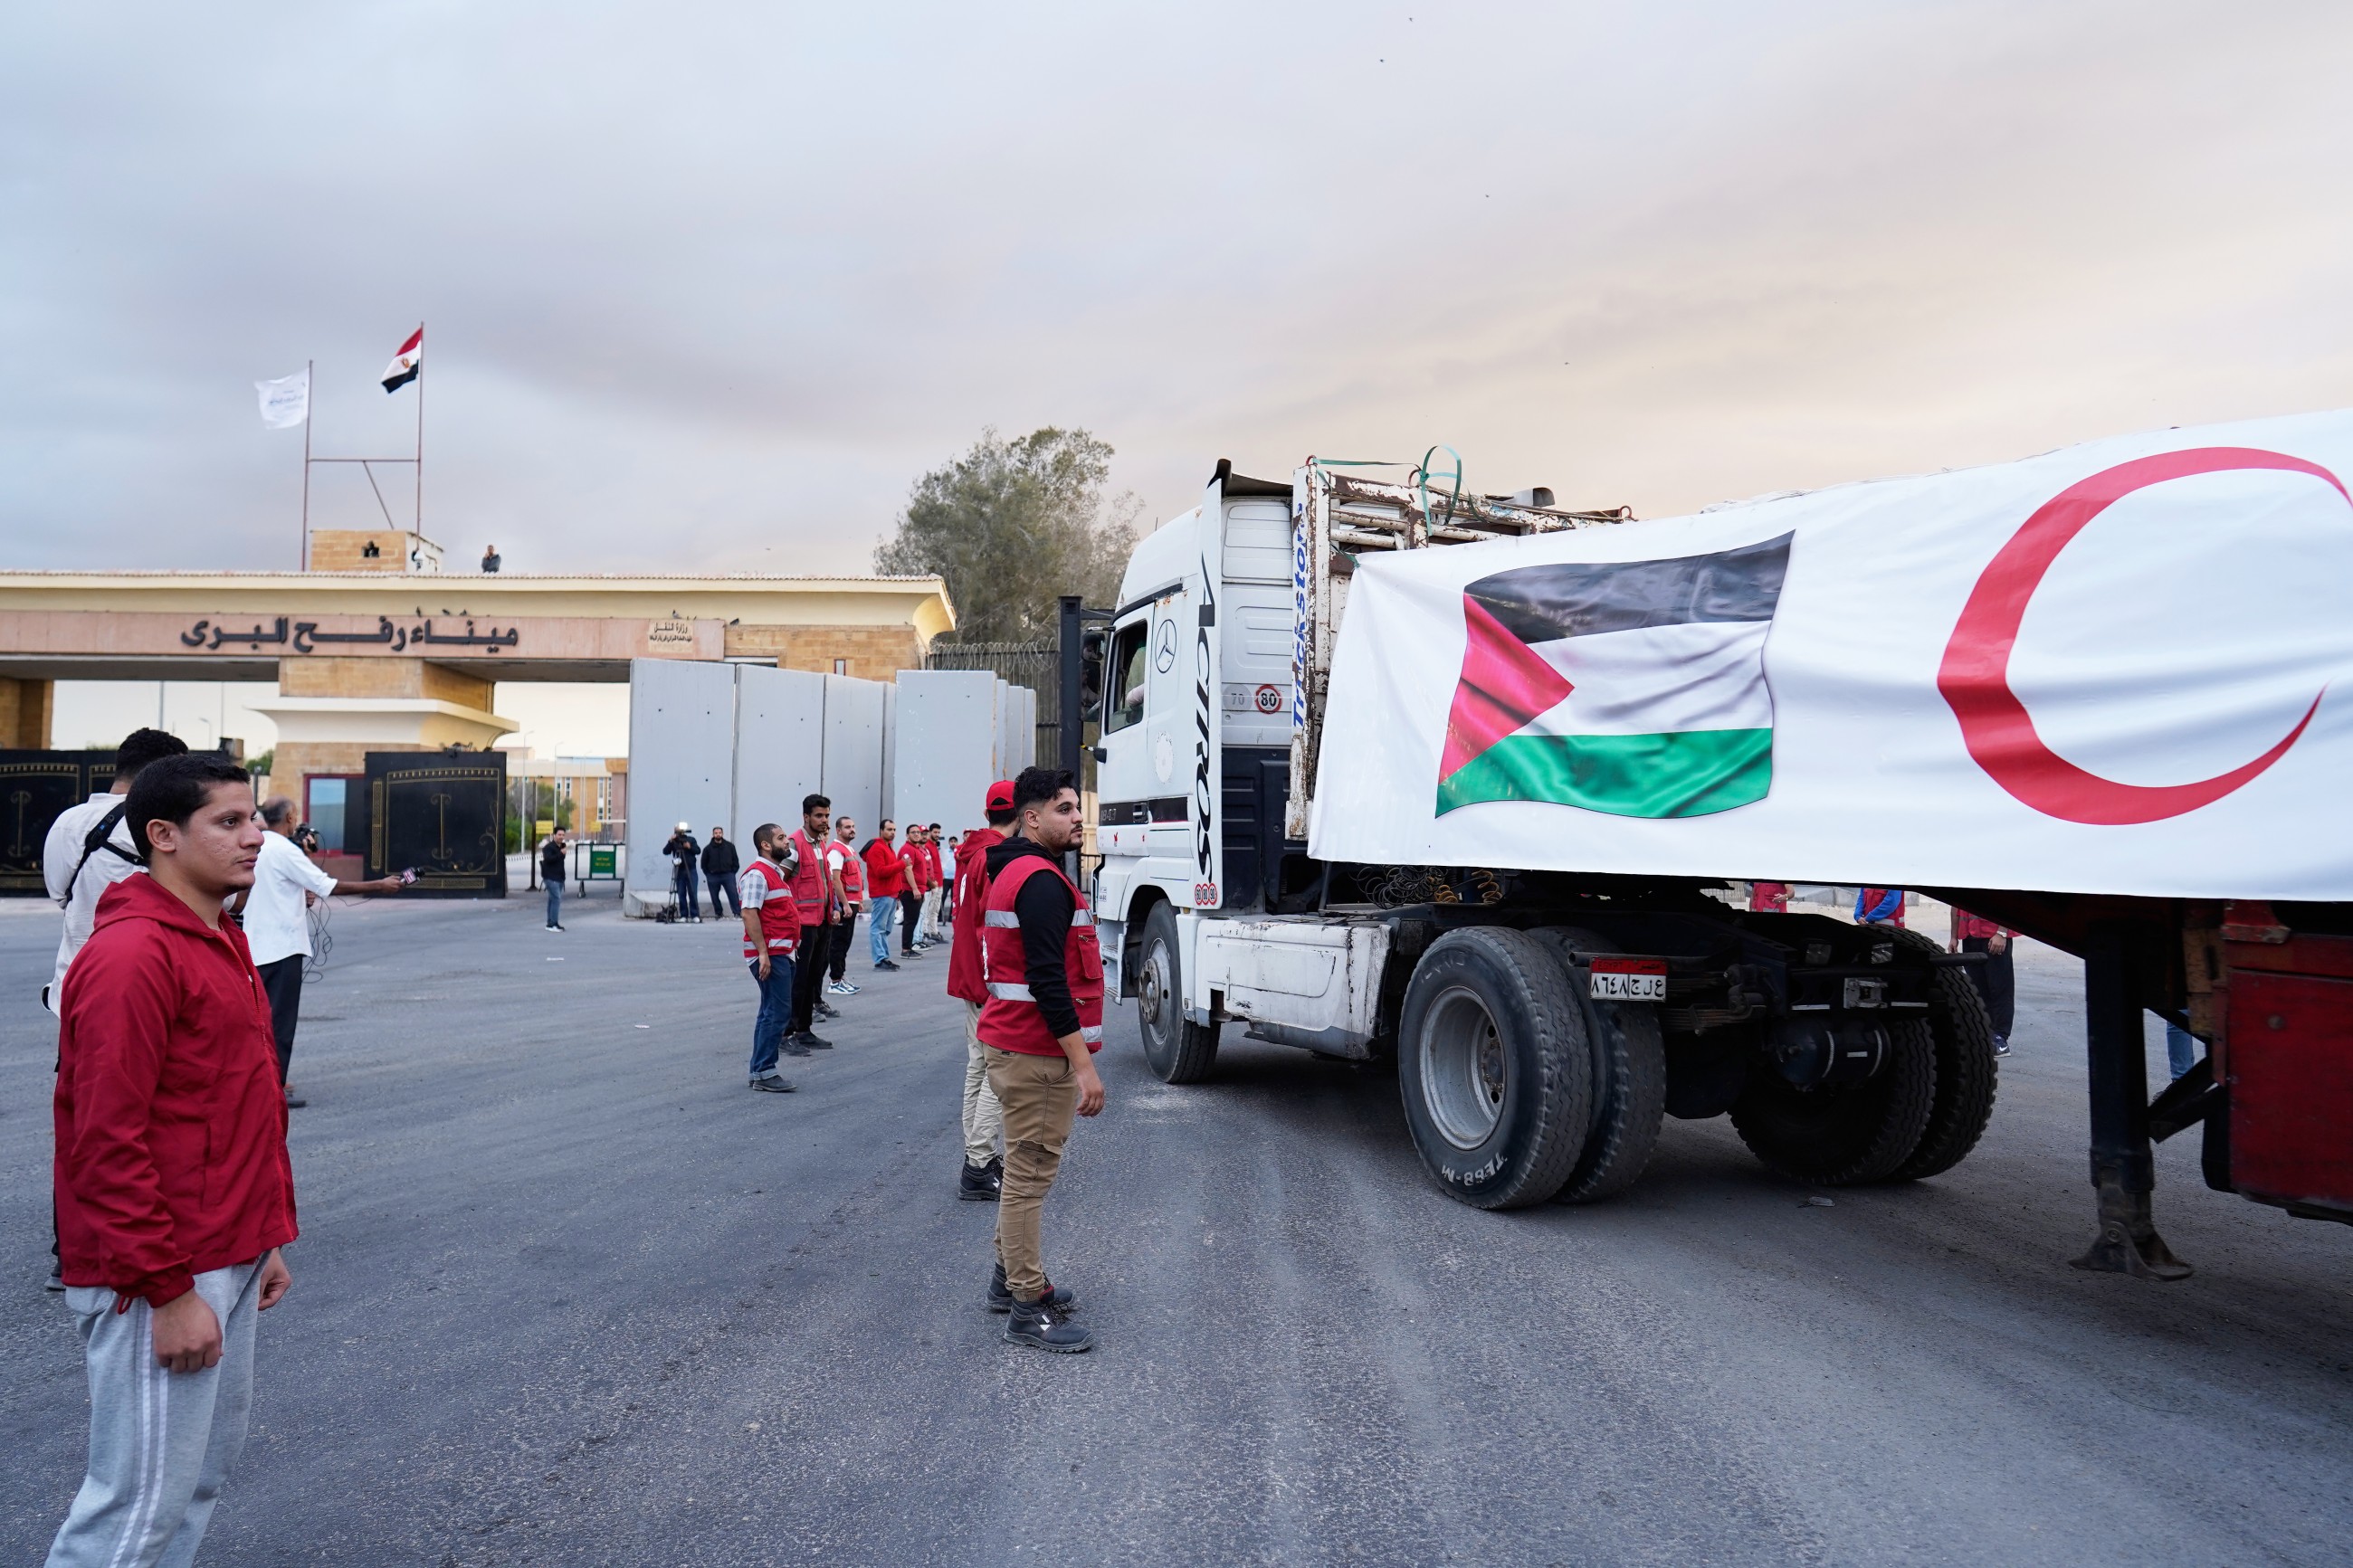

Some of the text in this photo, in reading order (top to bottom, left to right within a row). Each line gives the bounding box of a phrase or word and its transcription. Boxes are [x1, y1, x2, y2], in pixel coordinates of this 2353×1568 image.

[292, 615, 406, 653] رفح
[410, 619, 519, 653] ميناء
[1231, 693, 1245, 706] 70
[1261, 692, 1277, 707] 80
[1196, 550, 1215, 883] ACTROS
[1597, 961, 1623, 971] EGYPT
[1592, 976, 1627, 995] ٨٦٤٨
